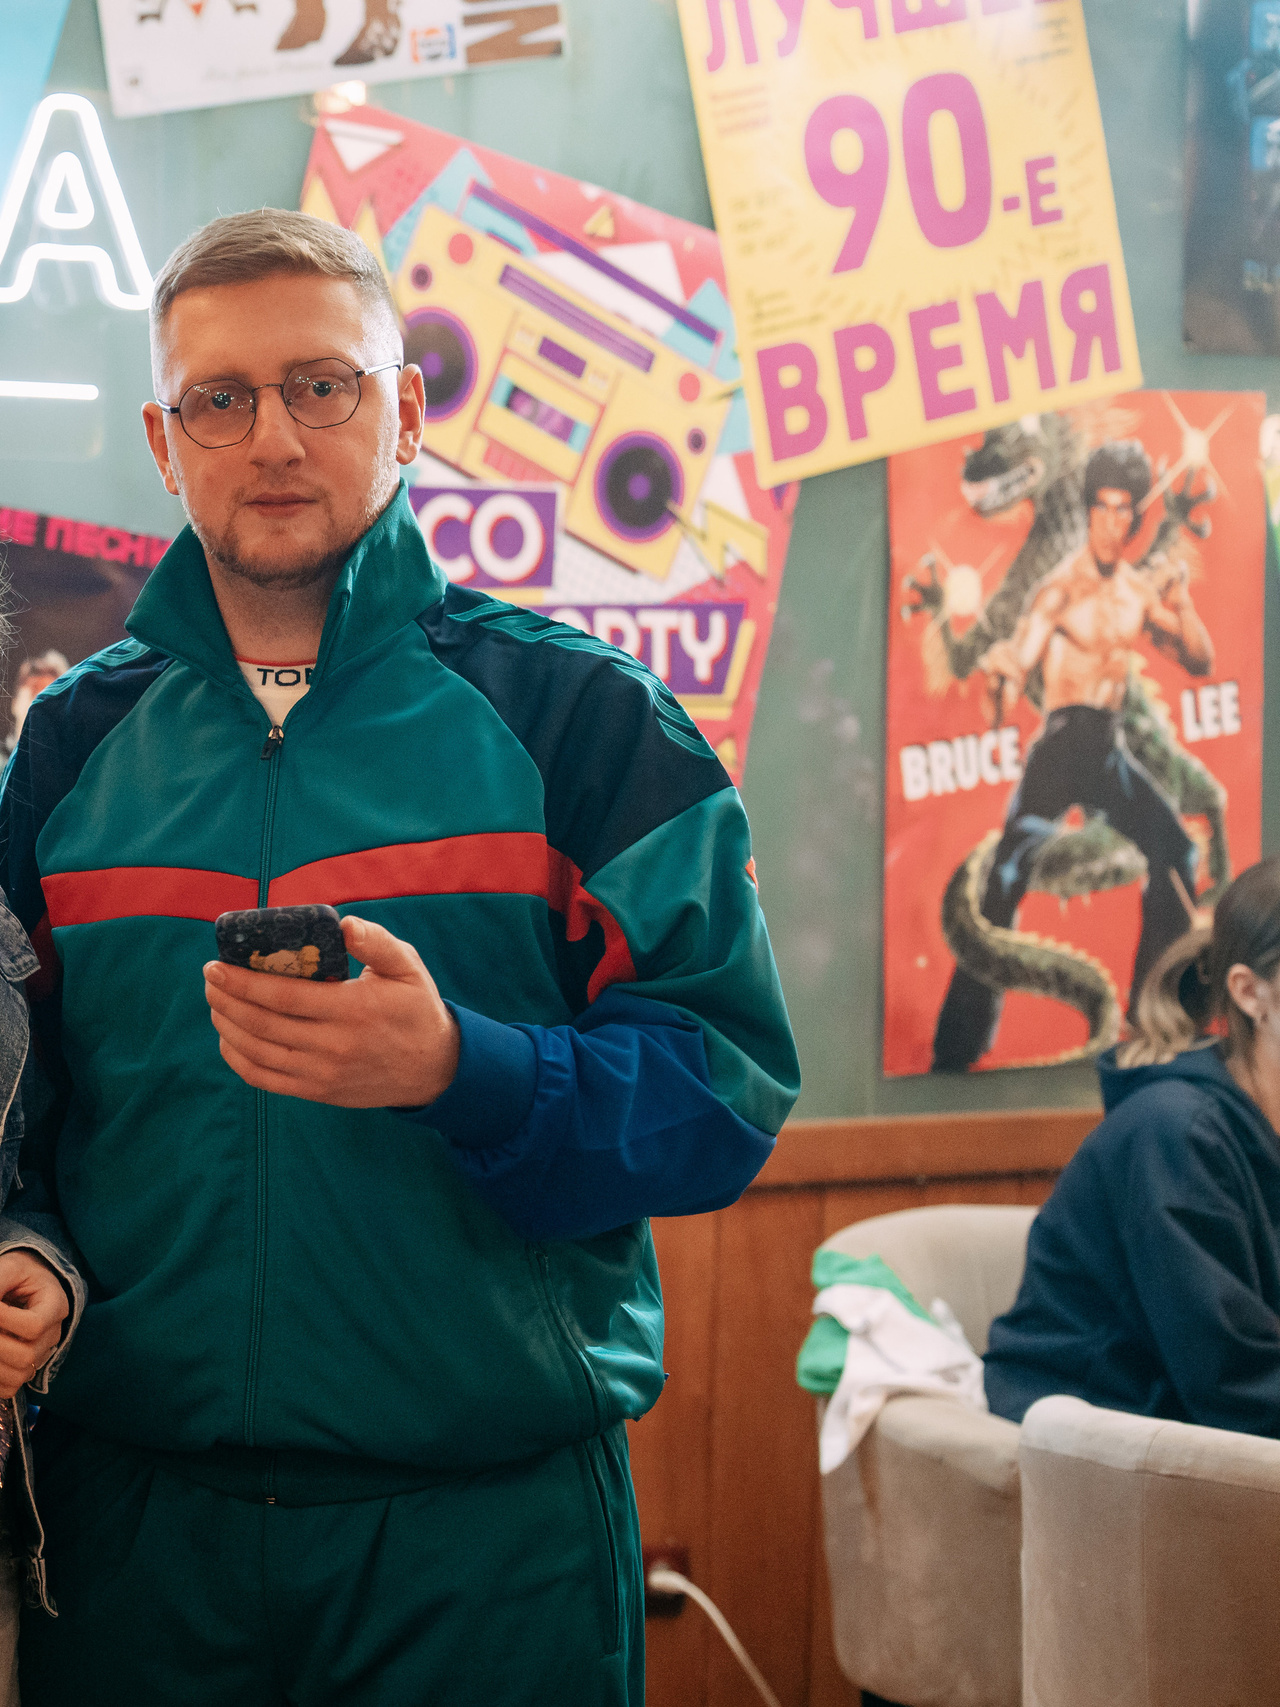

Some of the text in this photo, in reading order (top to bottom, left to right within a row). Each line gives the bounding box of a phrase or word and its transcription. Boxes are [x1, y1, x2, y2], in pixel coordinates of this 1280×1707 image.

[755, 263, 1122, 463] ВРЕМЯ
[898, 678, 1241, 801] BRUCE LEE
